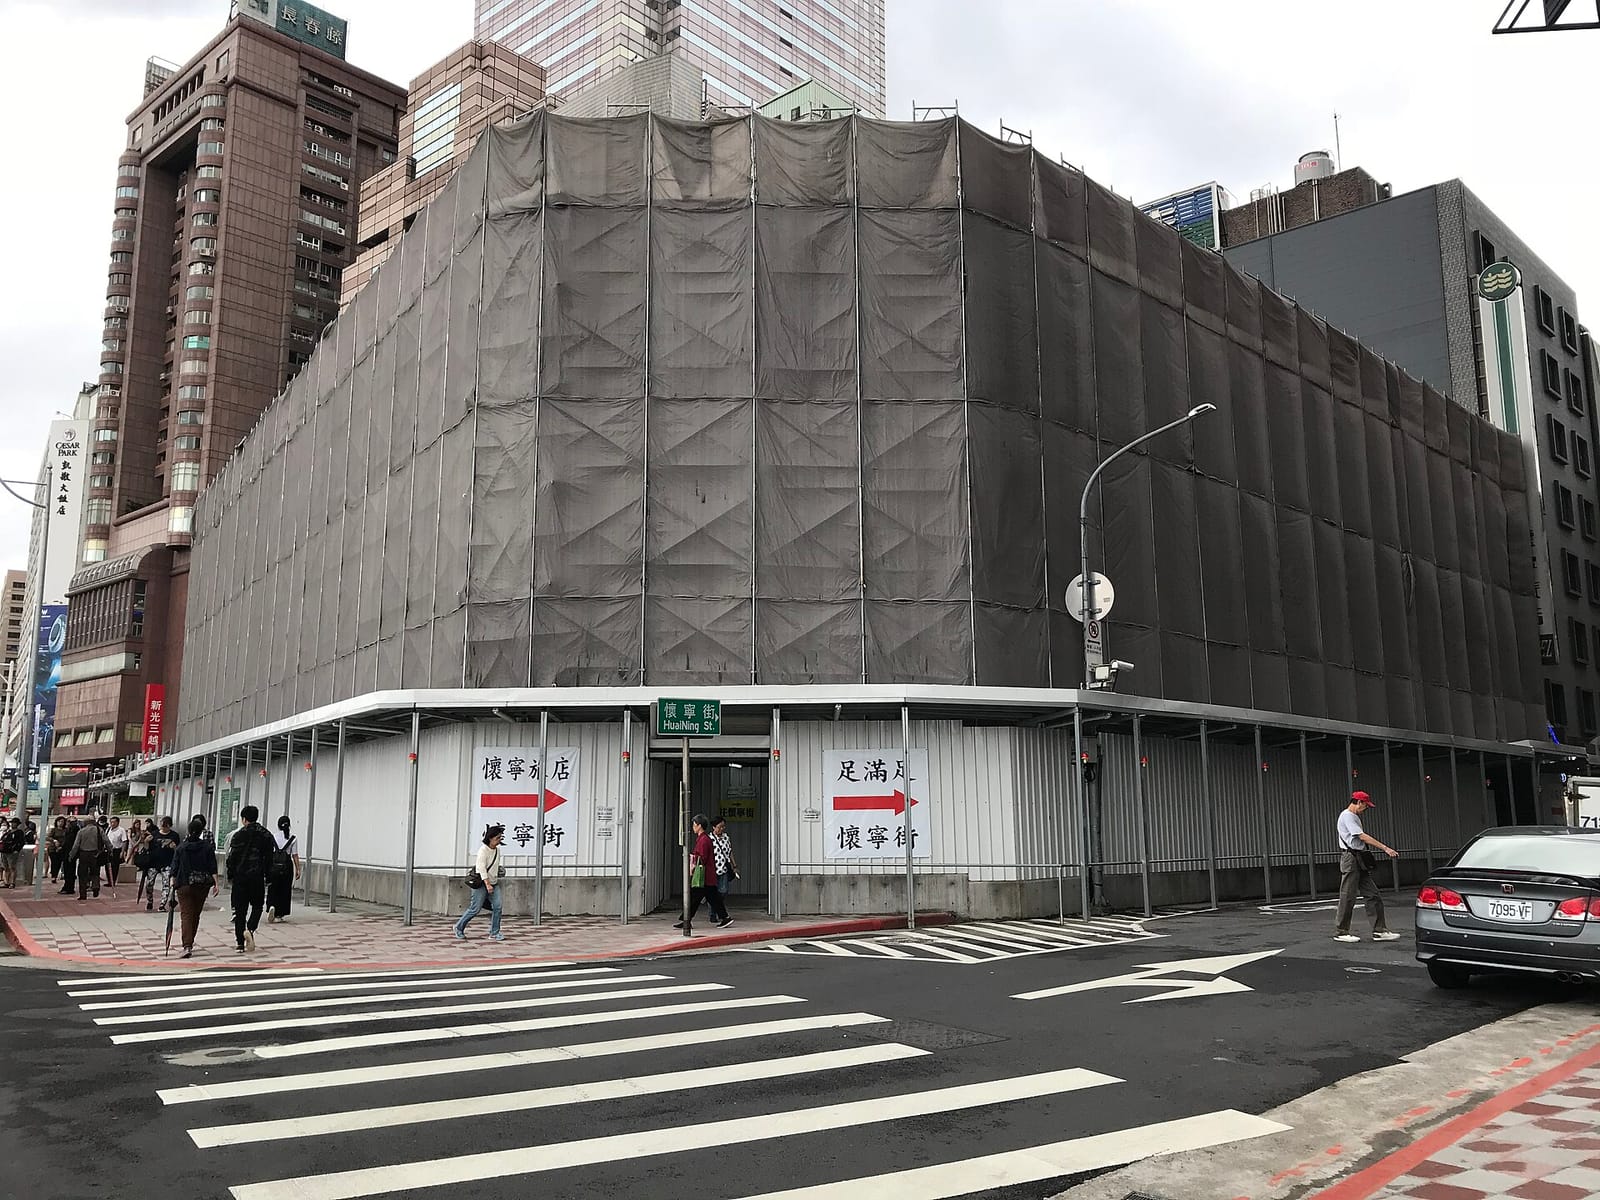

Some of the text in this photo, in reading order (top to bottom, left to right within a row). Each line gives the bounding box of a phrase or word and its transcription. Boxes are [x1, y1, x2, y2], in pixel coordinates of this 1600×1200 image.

[58, 449, 78, 457] PARK
[663, 702, 715, 720] 懷寧街
[147, 700, 162, 746] 新光三越
[663, 719, 715, 734] HuaiNing St.
[1580, 815, 1600, 828] 71
[837, 824, 919, 851] 懷寧街
